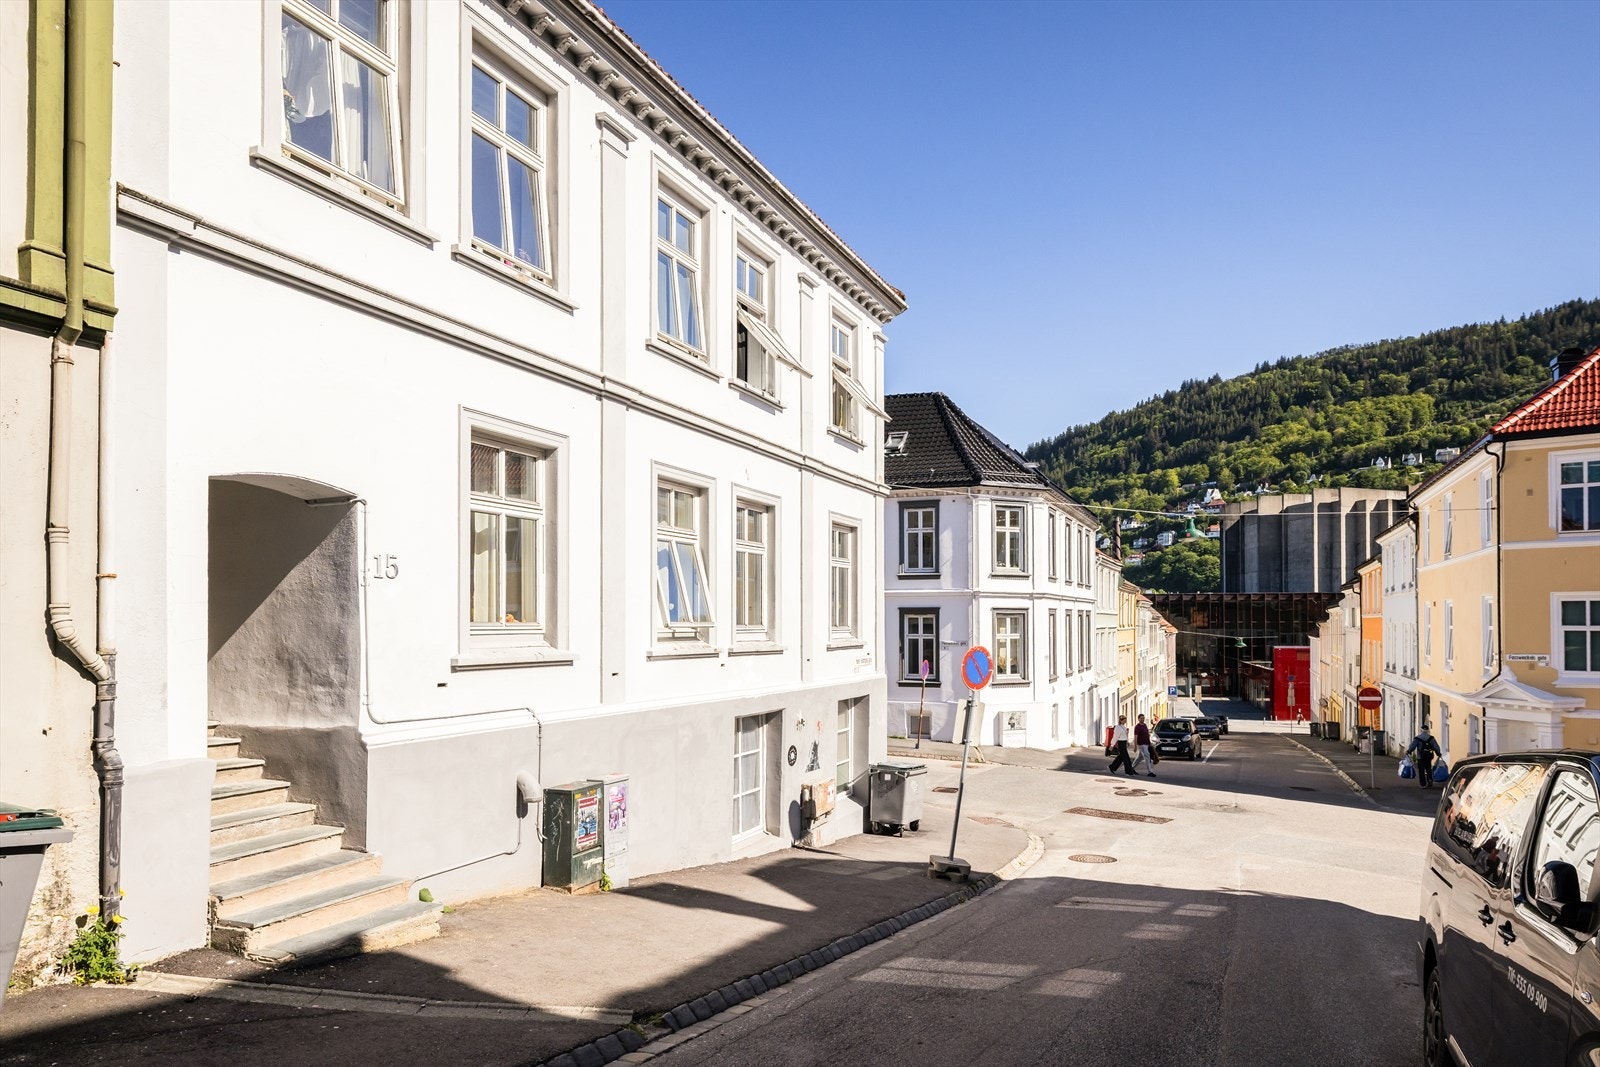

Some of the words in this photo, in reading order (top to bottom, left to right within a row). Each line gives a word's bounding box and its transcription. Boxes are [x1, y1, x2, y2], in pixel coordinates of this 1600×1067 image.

[373, 553, 399, 580] 15
[1515, 973, 1528, 994] 555
[1526, 983, 1535, 1002] 09
[1535, 990, 1548, 1013] 900
